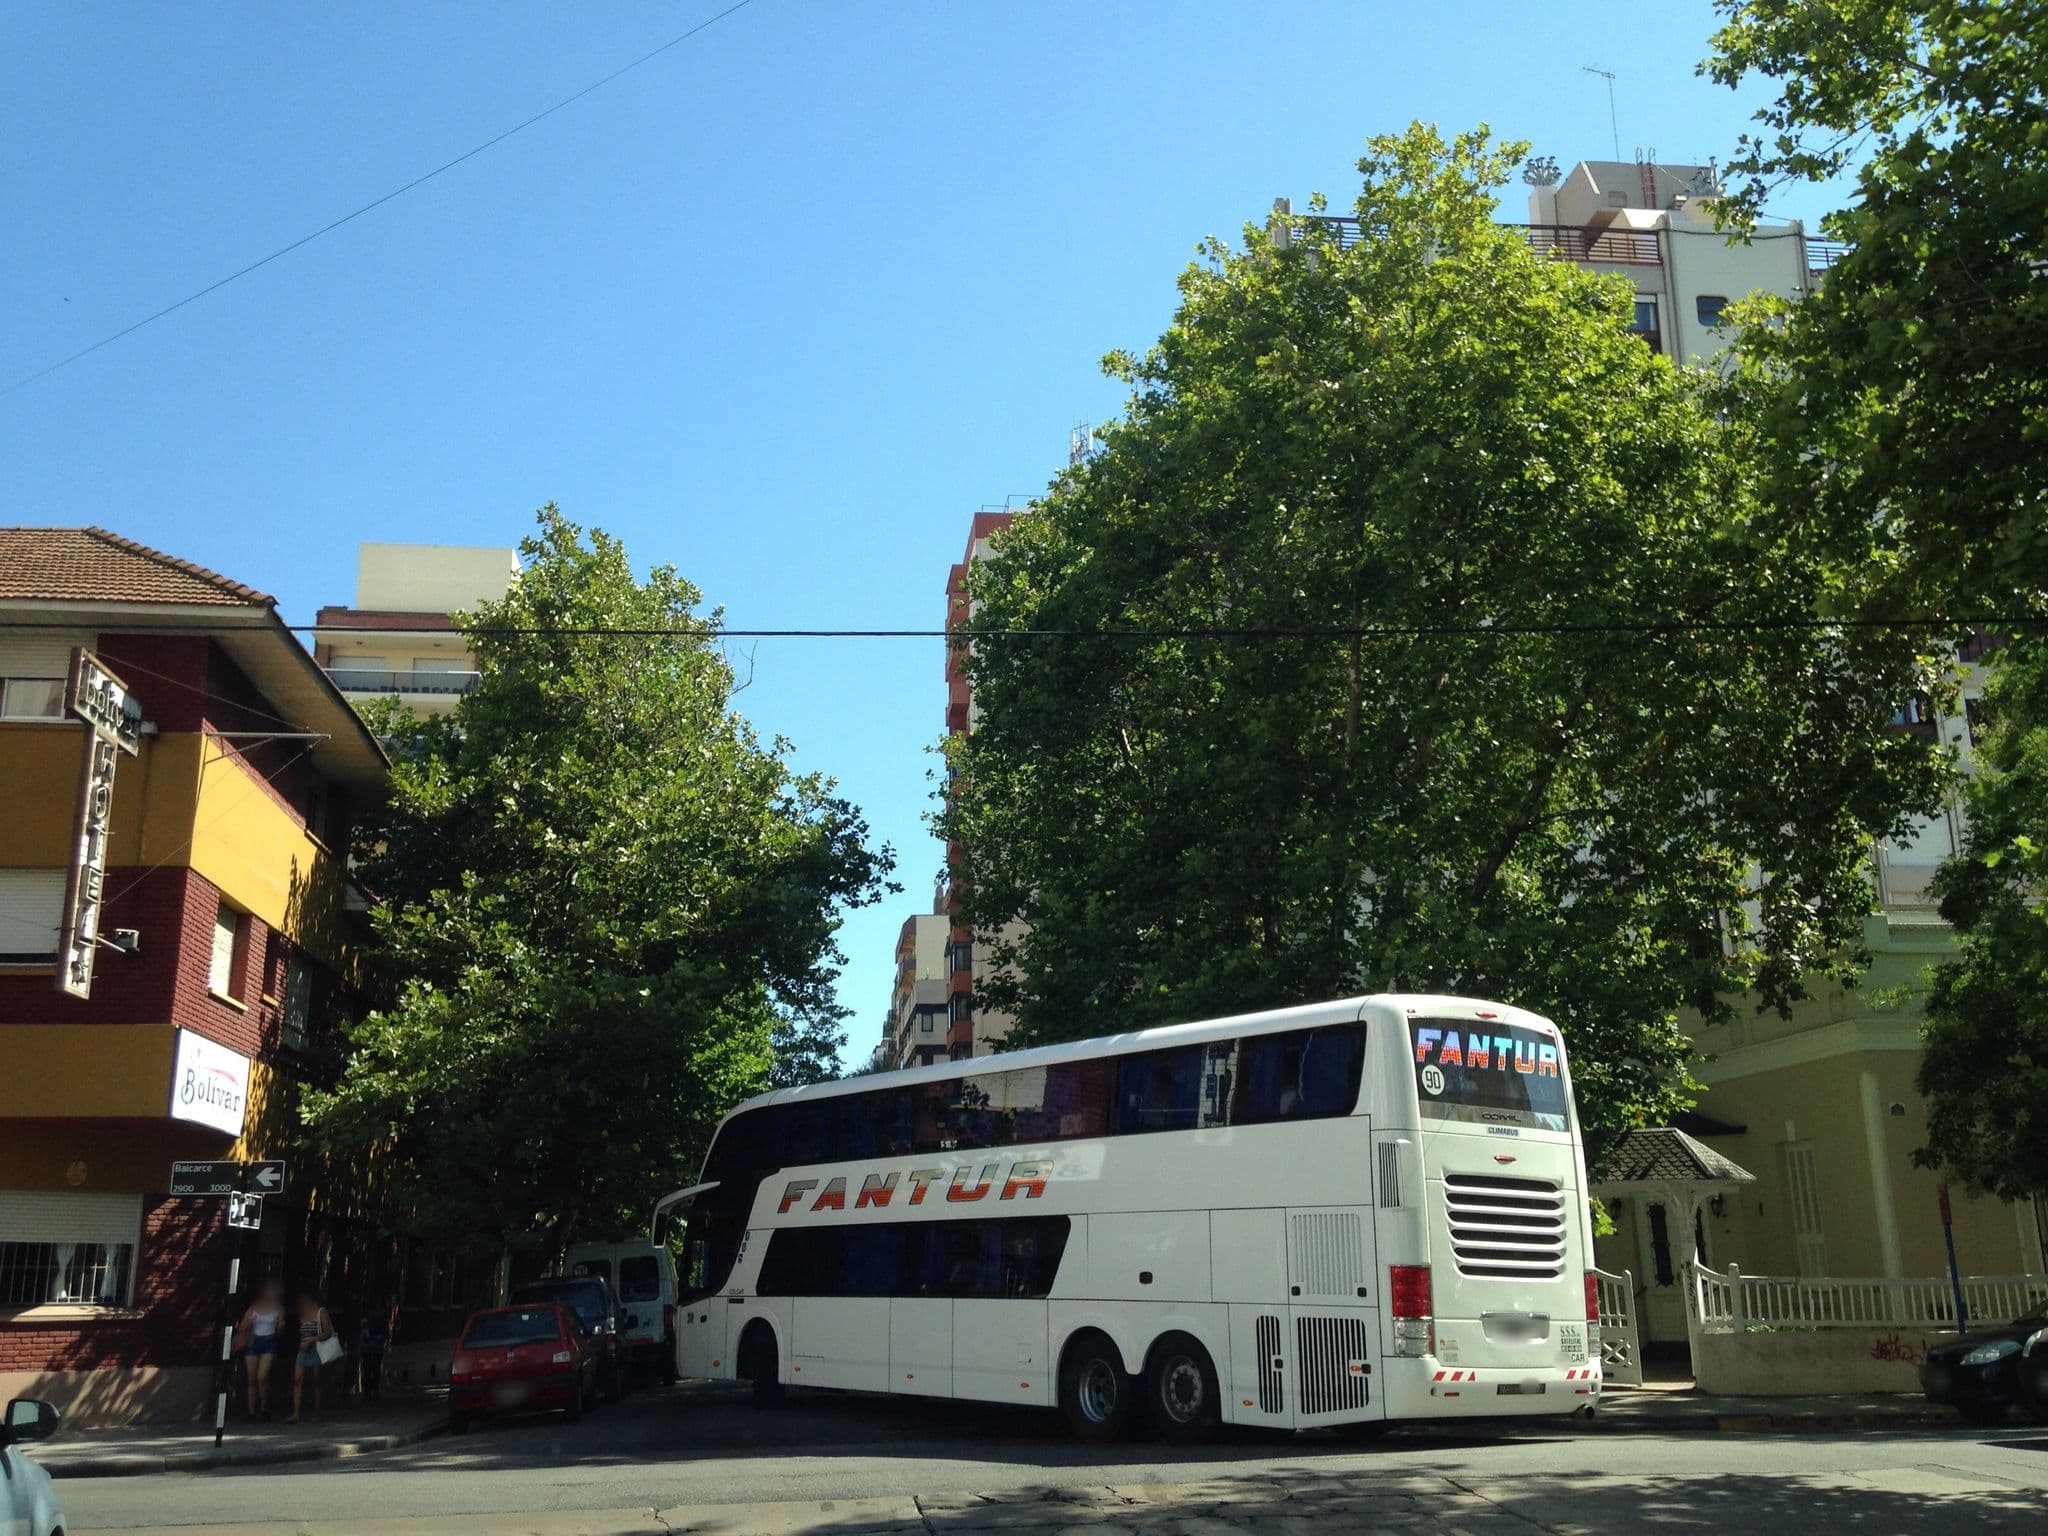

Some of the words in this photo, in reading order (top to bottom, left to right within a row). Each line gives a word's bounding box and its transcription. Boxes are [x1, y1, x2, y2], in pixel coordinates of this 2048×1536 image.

[1415, 1027, 1558, 1078] FANTUR
[1424, 1071, 1442, 1090] 90
[1487, 1126, 1519, 1137] CLIMABUS
[174, 1164, 213, 1173] Balcarce
[173, 1184, 195, 1193] 2900
[209, 1184, 232, 1192] 3000
[777, 1159, 1055, 1214] FANTUR
[1571, 1353, 1585, 1363] CAR
